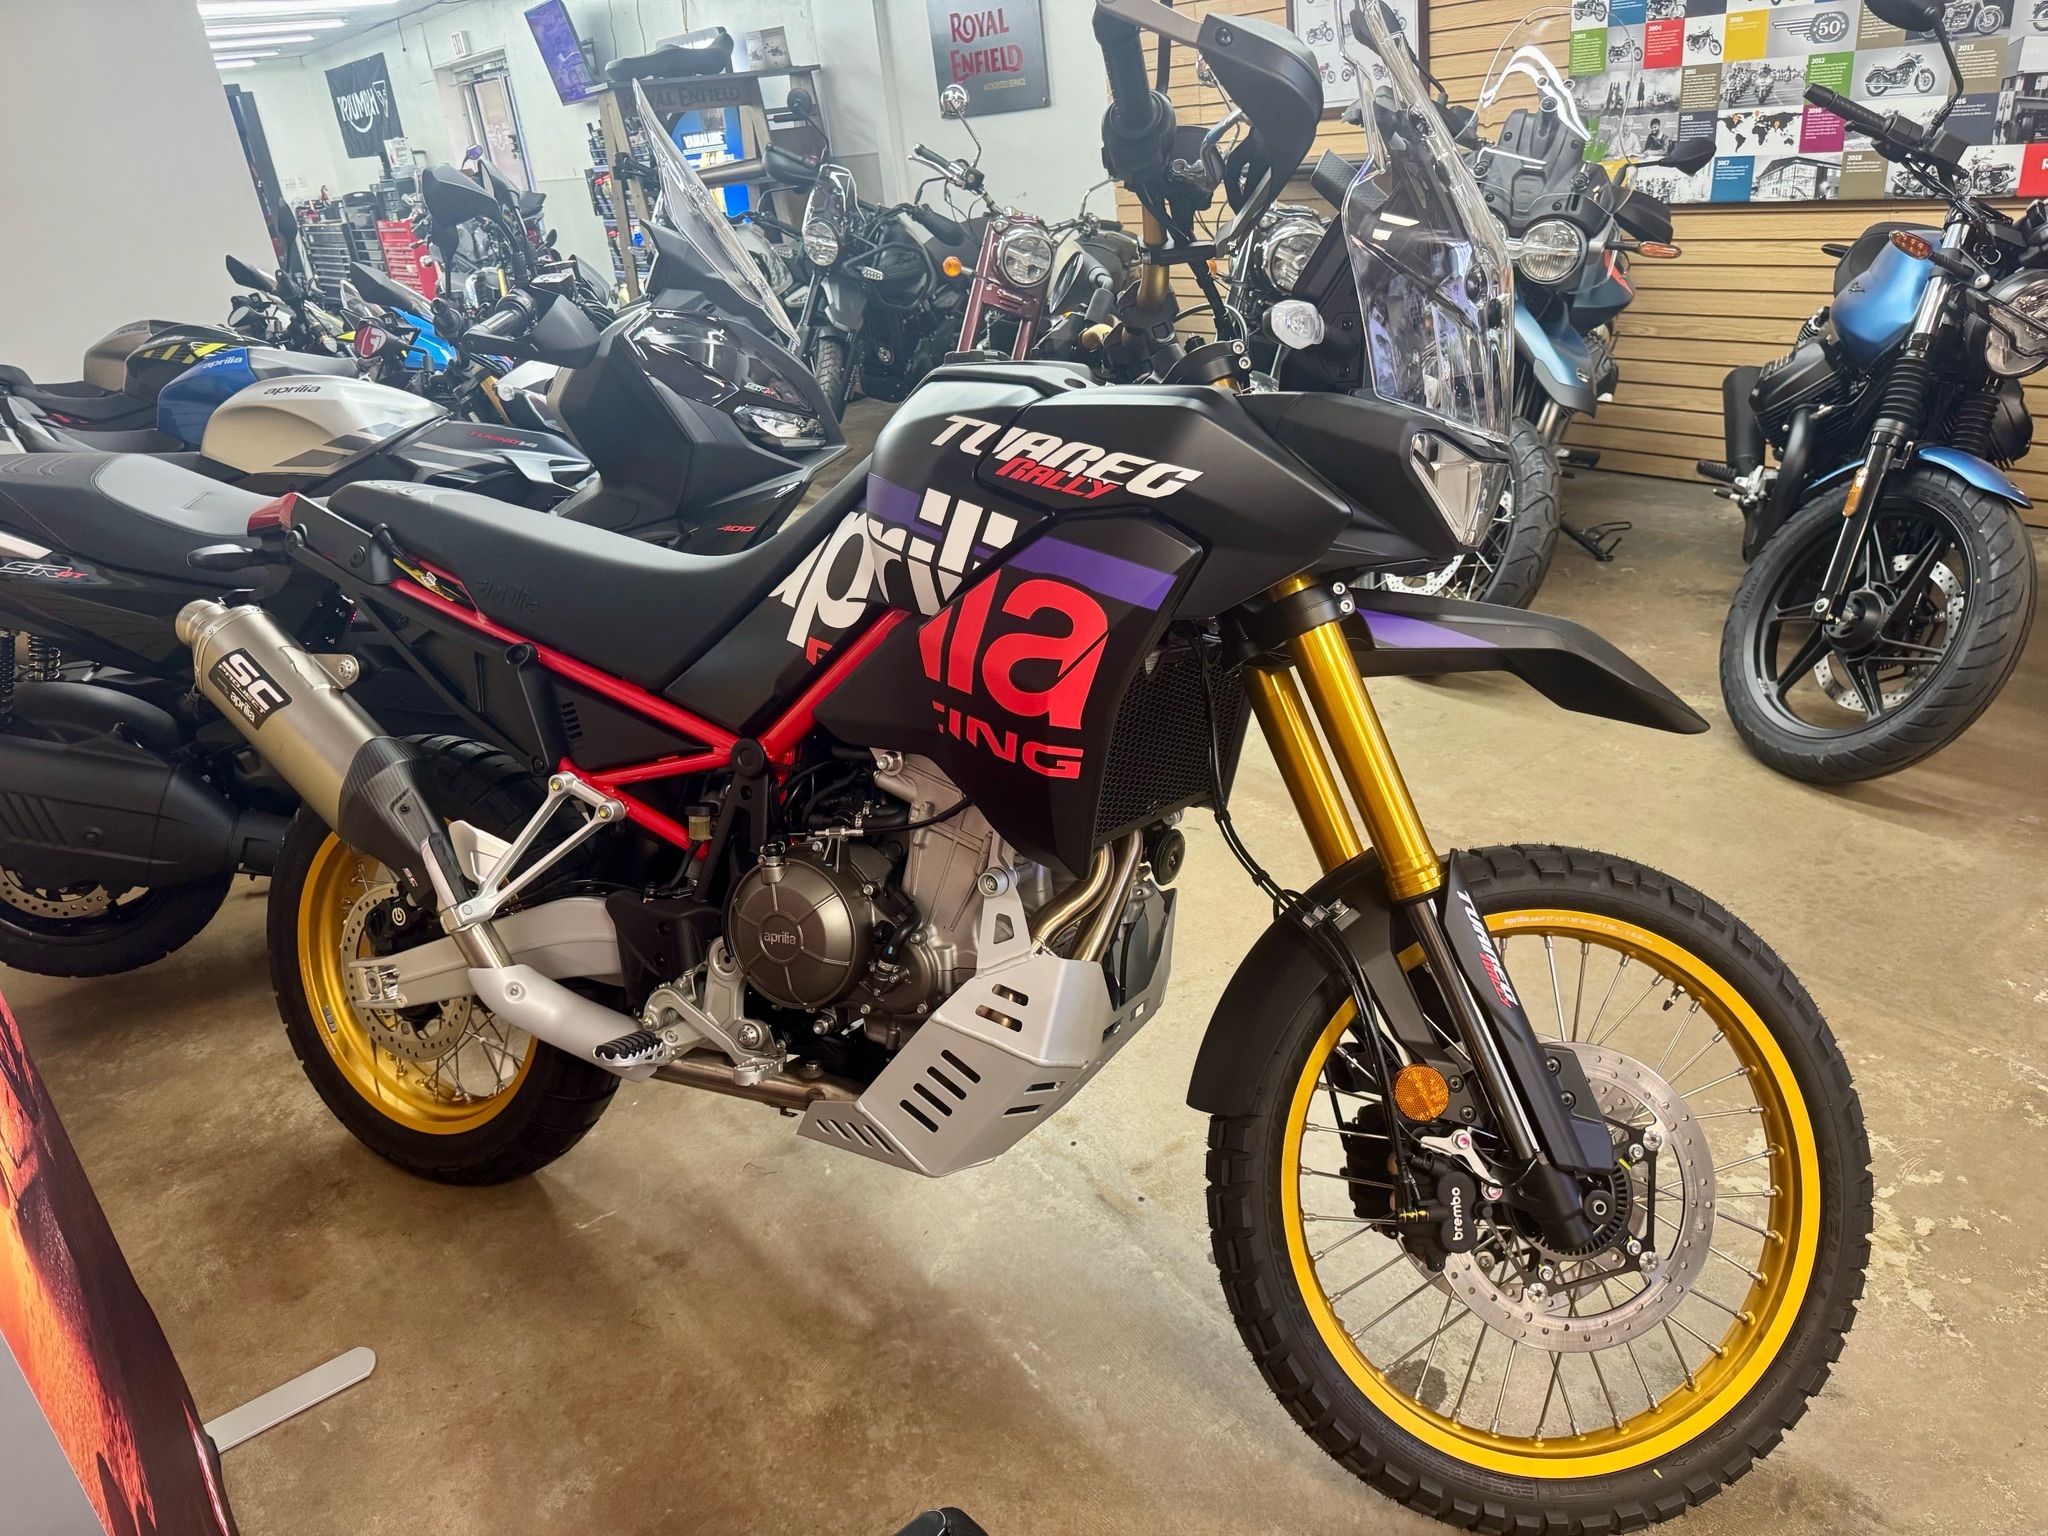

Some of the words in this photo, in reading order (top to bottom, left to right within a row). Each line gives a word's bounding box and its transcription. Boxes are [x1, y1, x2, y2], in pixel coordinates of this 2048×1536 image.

[949, 8, 1010, 43] ROYAL
[1818, 20, 1841, 36] 50
[950, 44, 1024, 84] ENFIELD
[1957, 44, 1975, 52] 2013
[337, 88, 380, 124] TRIUMPH
[679, 86, 741, 107] ENFIELD
[1807, 107, 1823, 115] 2016
[203, 355, 243, 370] aprilia
[264, 385, 321, 396] aprilia
[931, 415, 1204, 499] TUAREG
[995, 457, 1121, 499] RALLY
[716, 525, 757, 533] 400
[218, 664, 267, 714] PROJECT
[221, 653, 285, 712] SC
[230, 691, 255, 723] aprilia
[764, 931, 797, 946] aprilia
[1456, 890, 1519, 1006] TUAREG
[1450, 1186, 1464, 1242] brembo
[1816, 1149, 1842, 1301] PIRELLI
